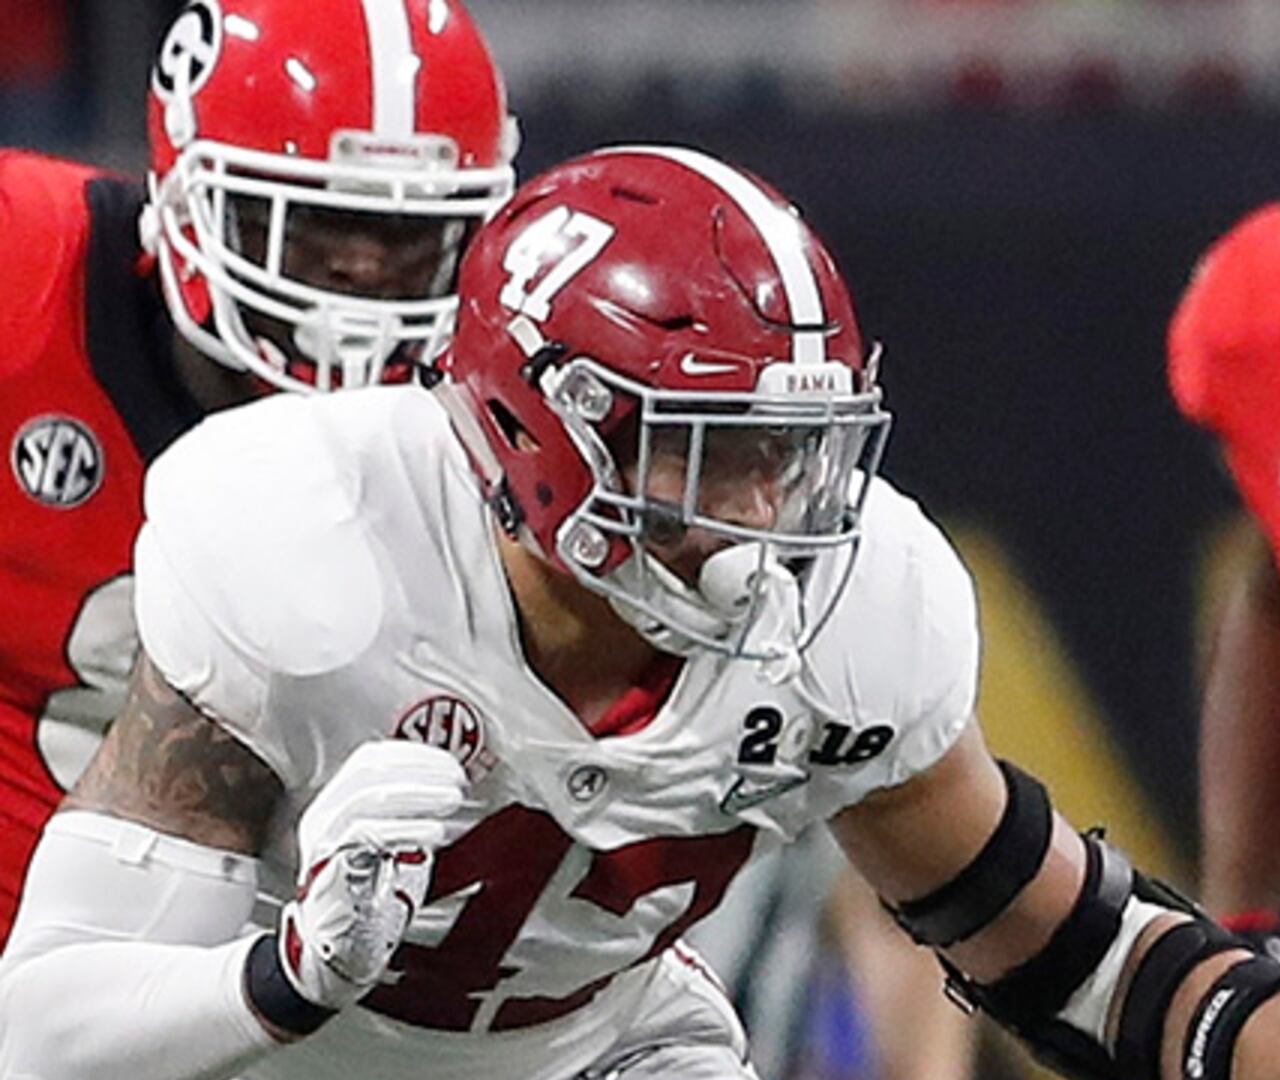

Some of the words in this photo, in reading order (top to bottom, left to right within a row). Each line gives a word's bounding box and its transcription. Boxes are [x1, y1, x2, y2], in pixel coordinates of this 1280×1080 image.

[500, 206, 616, 322] 47
[787, 373, 835, 393] BAMA
[17, 428, 96, 502] SEC
[401, 700, 476, 758] SEC
